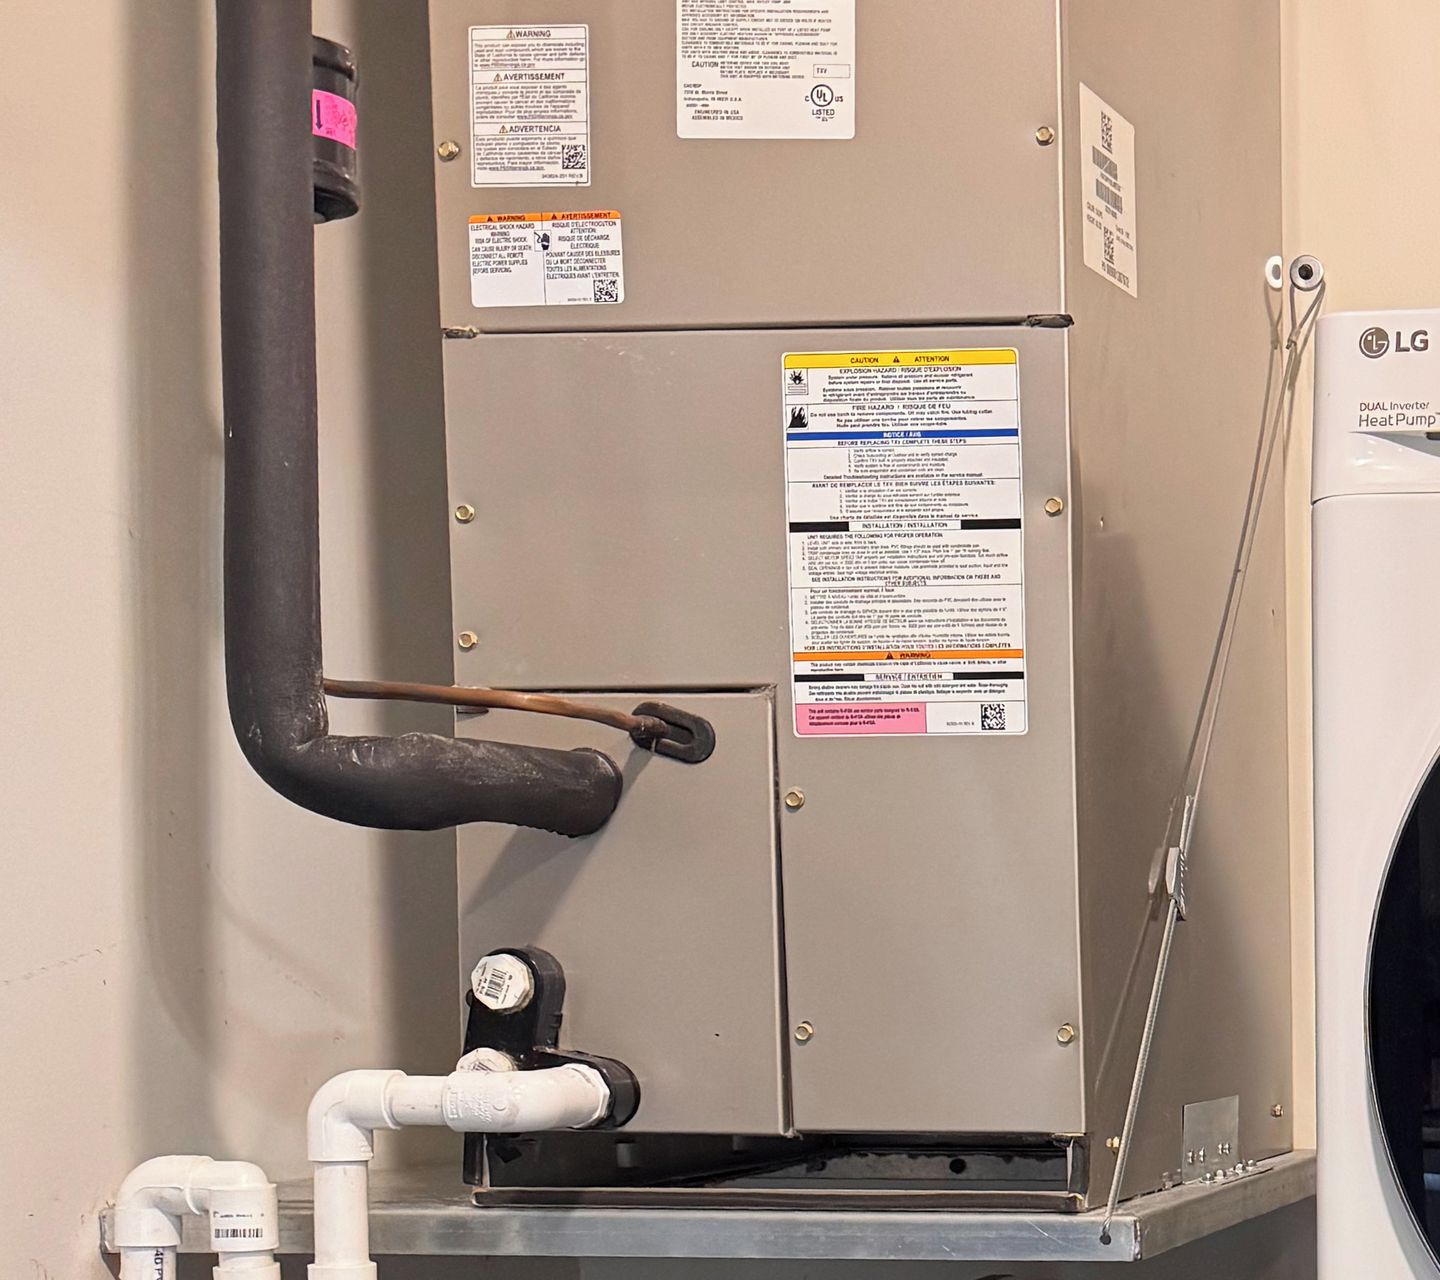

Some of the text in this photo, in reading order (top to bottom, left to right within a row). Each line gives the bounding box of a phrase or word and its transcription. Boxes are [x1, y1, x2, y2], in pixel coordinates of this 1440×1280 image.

[516, 30, 551, 38] WARNING
[503, 72, 565, 81] AVERTISSEMENT
[509, 125, 561, 133] ADVERTENCIA
[561, 212, 612, 221] AVERTISSEMENT
[1395, 329, 1429, 353] LG
[1359, 401, 1430, 412] DUAL Inverter
